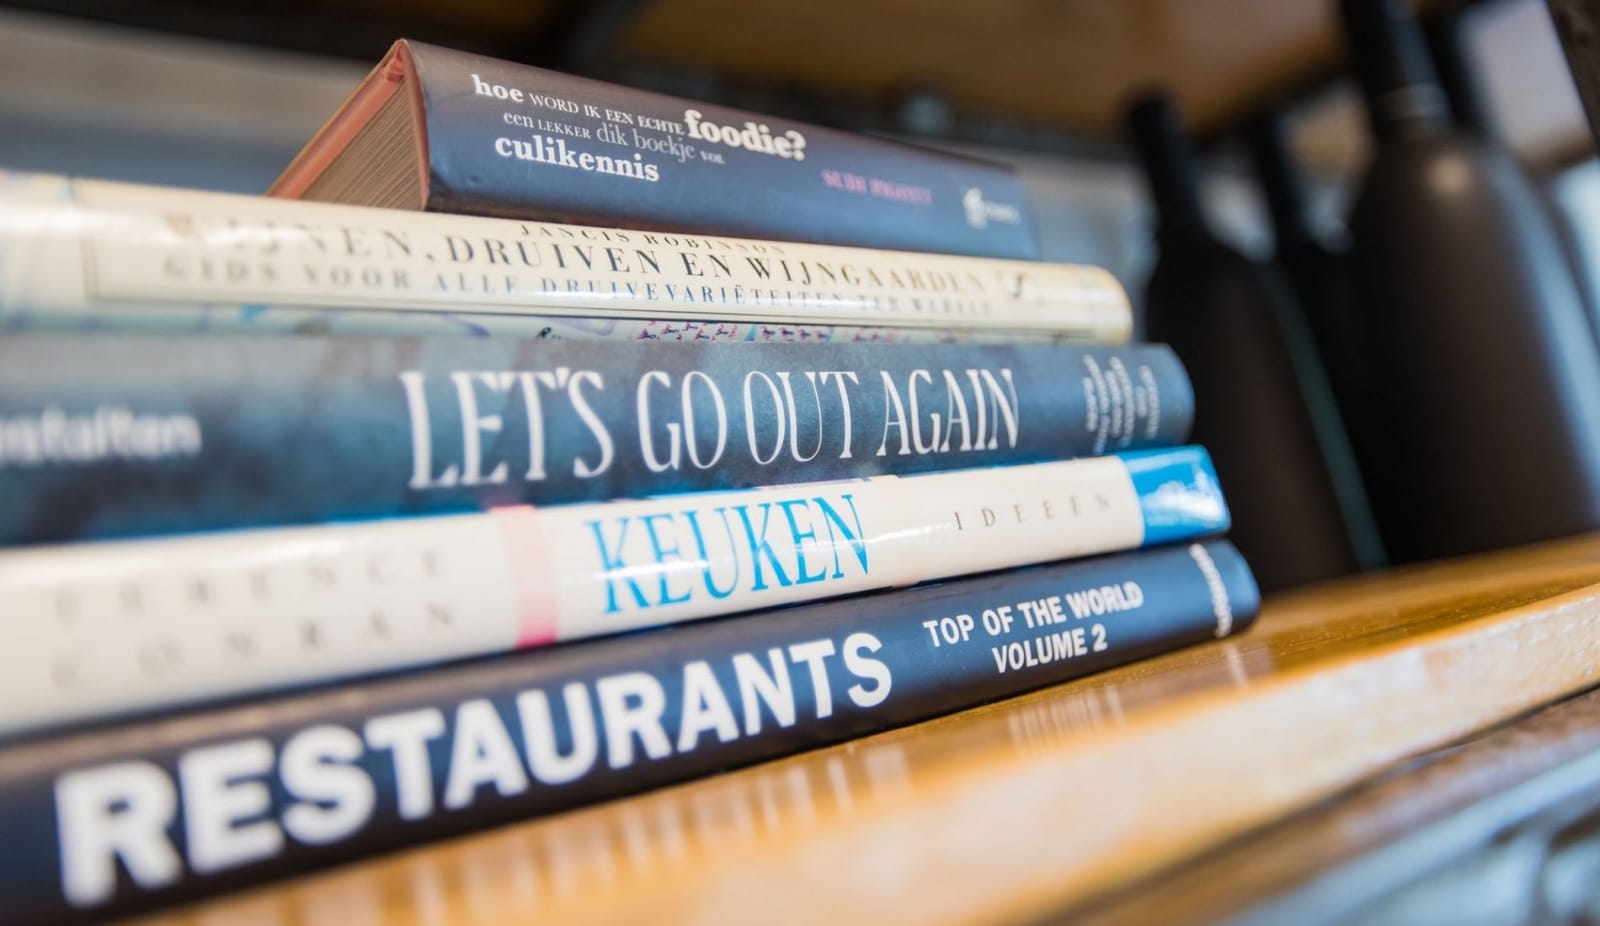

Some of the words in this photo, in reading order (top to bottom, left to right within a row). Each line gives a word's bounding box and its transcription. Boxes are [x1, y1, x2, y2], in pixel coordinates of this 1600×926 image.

[471, 74, 525, 103] hoe
[529, 93, 579, 114] WORD
[584, 104, 601, 119] IK
[605, 108, 633, 126] EEN
[638, 115, 684, 136] ECHTE
[684, 109, 807, 161] foodie?
[503, 111, 534, 129] een
[538, 119, 591, 139] LEKKER
[596, 122, 628, 146] dik
[632, 128, 696, 163] boekje
[495, 134, 660, 182] culikennis
[446, 235, 663, 275] DRUIVEN
[678, 251, 733, 278] EN
[745, 256, 986, 295] WIJNGAARDEN
[521, 224, 630, 244] JANCIS
[643, 234, 785, 255] ROBINSON
[303, 264, 411, 290] VOOR
[401, 367, 616, 490] LET'S
[637, 370, 727, 472] GO
[745, 370, 859, 464] OUT
[876, 368, 1021, 455] AGAIN
[585, 493, 871, 615] KEUKEN
[922, 614, 975, 648] TOP
[982, 606, 1014, 636] OF
[1017, 596, 1067, 629] THE
[1066, 581, 1144, 619] WORLD
[992, 628, 1088, 673] VOLUME
[1091, 623, 1108, 652] 2
[54, 632, 893, 907] RESTAURANTS
